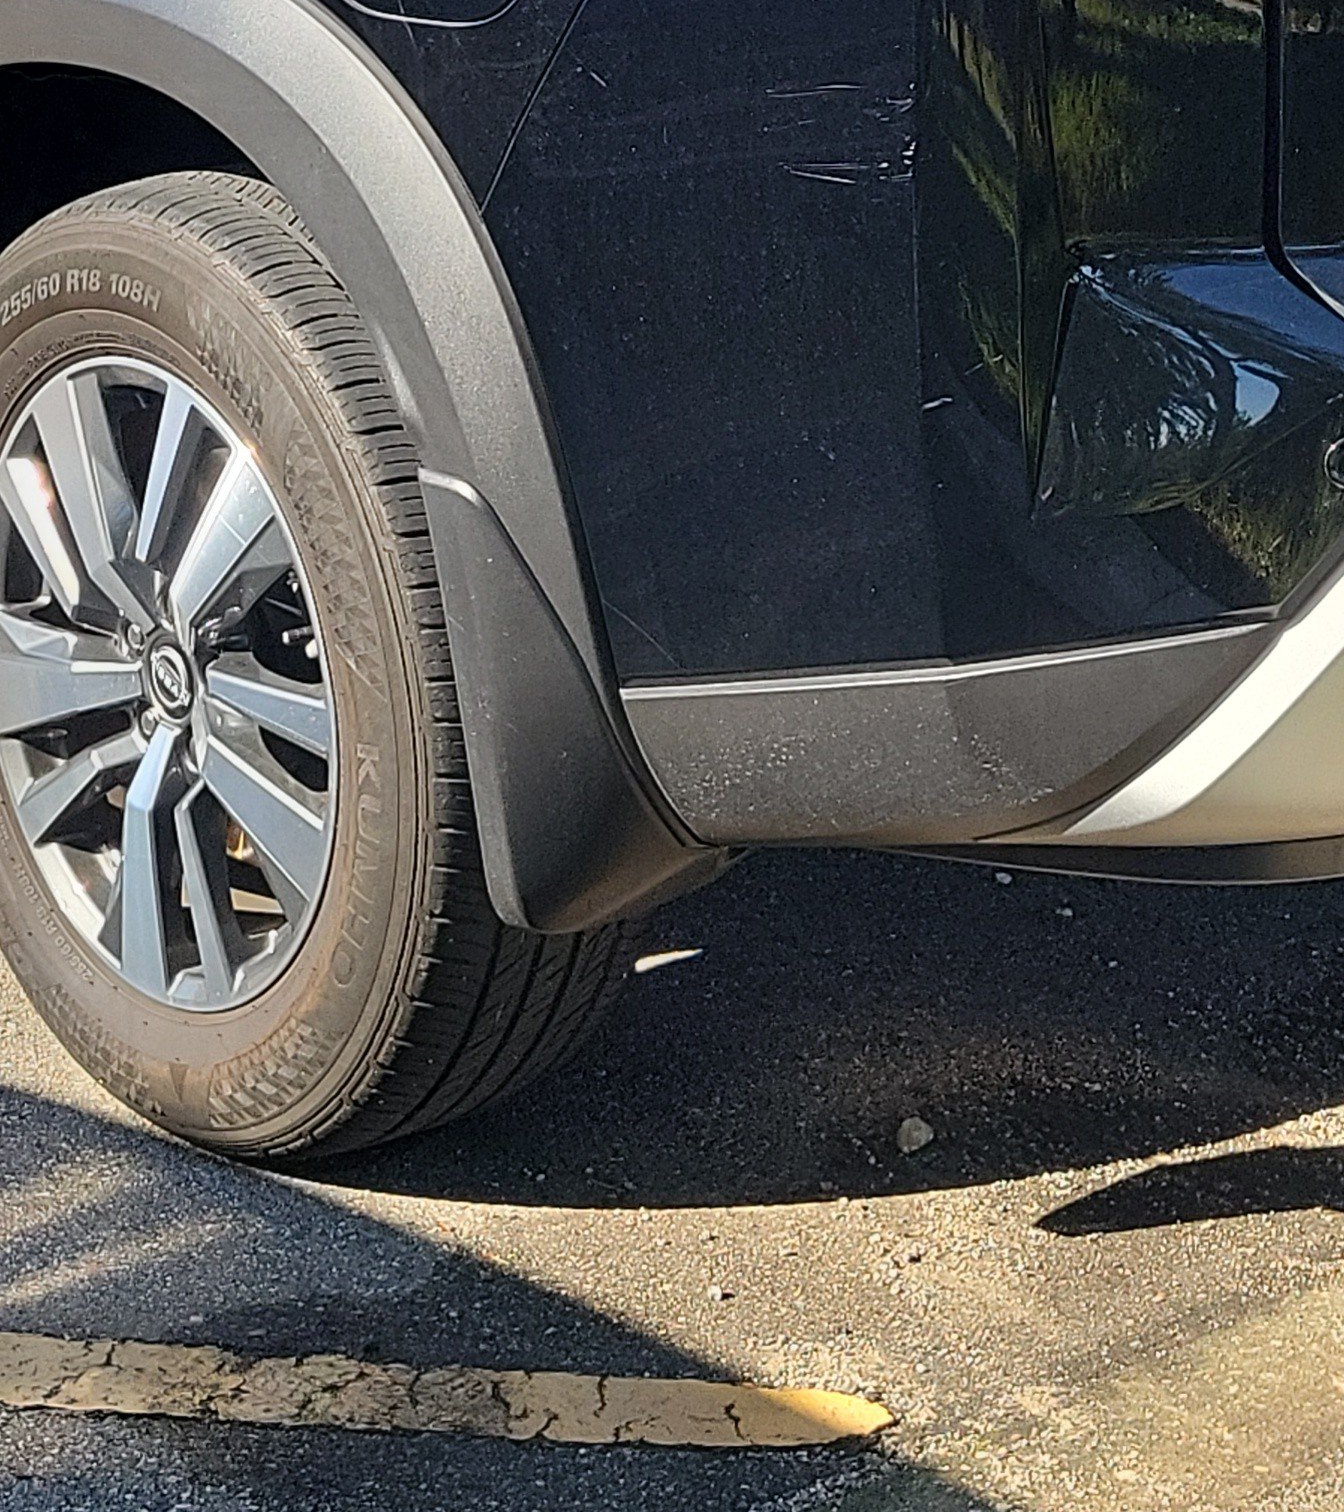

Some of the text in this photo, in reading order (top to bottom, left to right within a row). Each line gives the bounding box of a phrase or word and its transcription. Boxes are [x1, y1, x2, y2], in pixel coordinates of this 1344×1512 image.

[0, 268, 161, 326] 255/60 R18 108H
[331, 742, 381, 987] KUMHO
